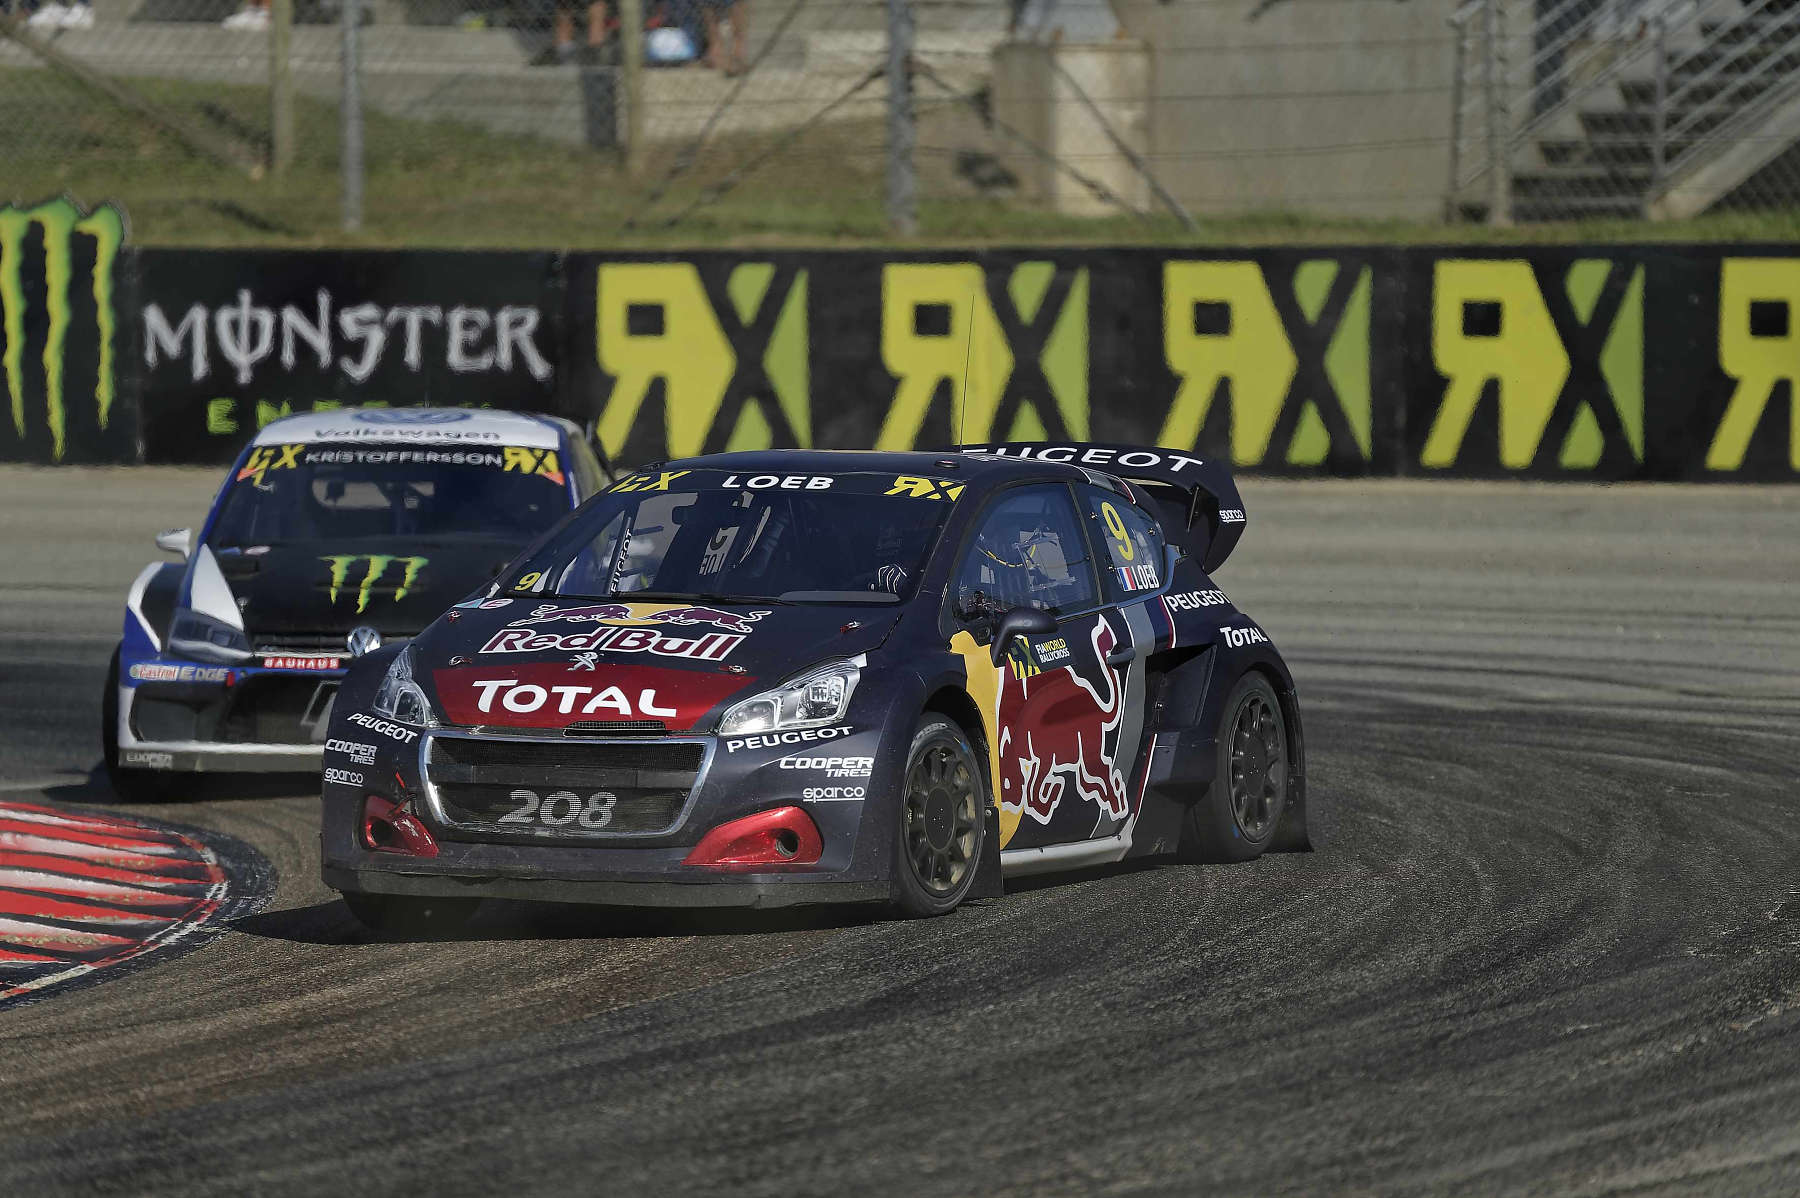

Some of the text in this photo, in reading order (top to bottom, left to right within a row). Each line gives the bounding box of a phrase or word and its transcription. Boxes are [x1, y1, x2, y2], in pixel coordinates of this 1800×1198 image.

[143, 287, 552, 384] MONSTER
[1705, 257, 1800, 471] R
[314, 428, 501, 440] Volkswagen
[304, 451, 503, 467] KRISTOFFERSSON
[722, 475, 835, 490] LOEB
[1101, 501, 1134, 561] 9
[514, 572, 541, 591] 9
[1132, 564, 1160, 590] LOEB
[1166, 590, 1231, 612] PEUGEOT
[478, 626, 746, 661] Red Bull
[1219, 626, 1268, 648] TOTAL
[264, 658, 339, 669] BAUHAUS
[1039, 647, 1071, 663] RALLYCROSS
[472, 679, 677, 717] TOTAL
[347, 713, 418, 744] PEUGEOT
[325, 738, 378, 757] COOPER
[727, 726, 853, 753] PEUGEOT
[349, 753, 376, 766] TIRES
[780, 757, 874, 770] COOPER
[324, 767, 364, 787] sparco
[825, 768, 873, 778] TIRES
[802, 786, 865, 803] sparco
[498, 789, 617, 828] 208
